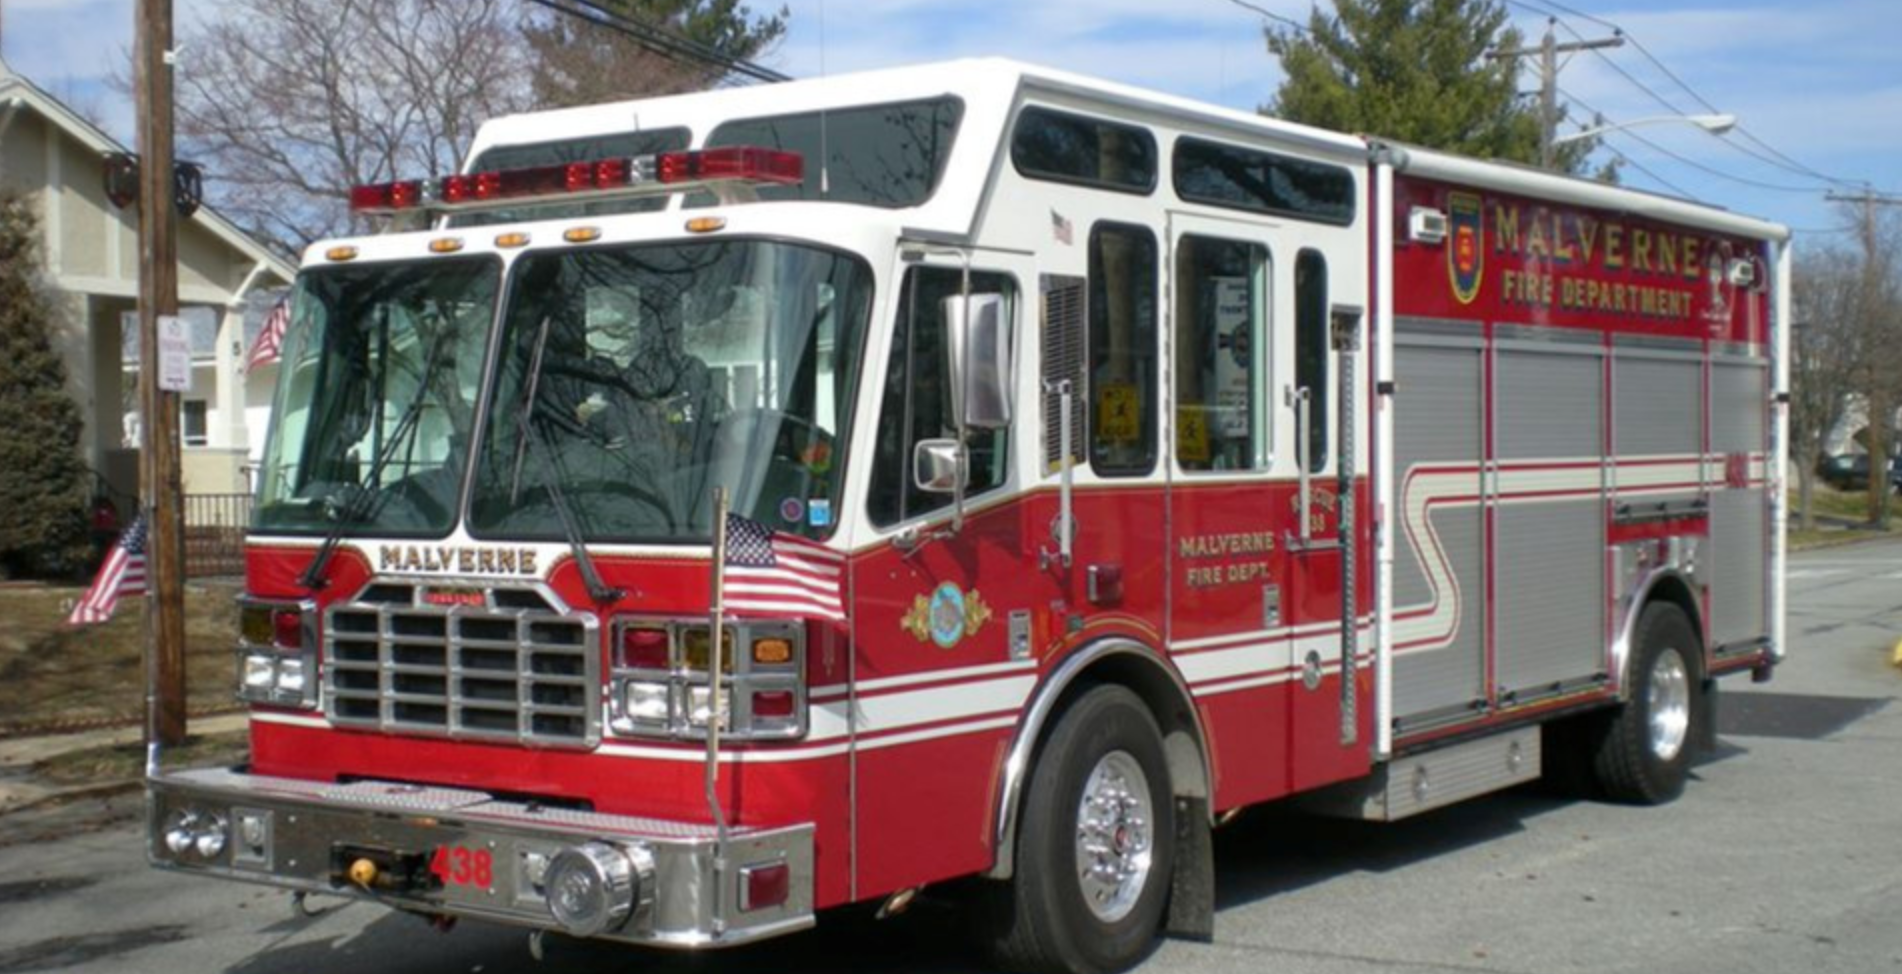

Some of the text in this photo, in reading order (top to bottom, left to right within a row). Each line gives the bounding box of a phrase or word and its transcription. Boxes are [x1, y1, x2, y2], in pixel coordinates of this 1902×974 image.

[1494, 202, 1701, 282] MALVERNE
[1502, 269, 1553, 308] FIRE
[1561, 276, 1693, 321] DEPARTMENT
[379, 545, 537, 574] MALVERNE
[1180, 531, 1275, 558] MALVERNE
[1187, 561, 1269, 587] FIRE DEPT.
[430, 845, 493, 889] 438
